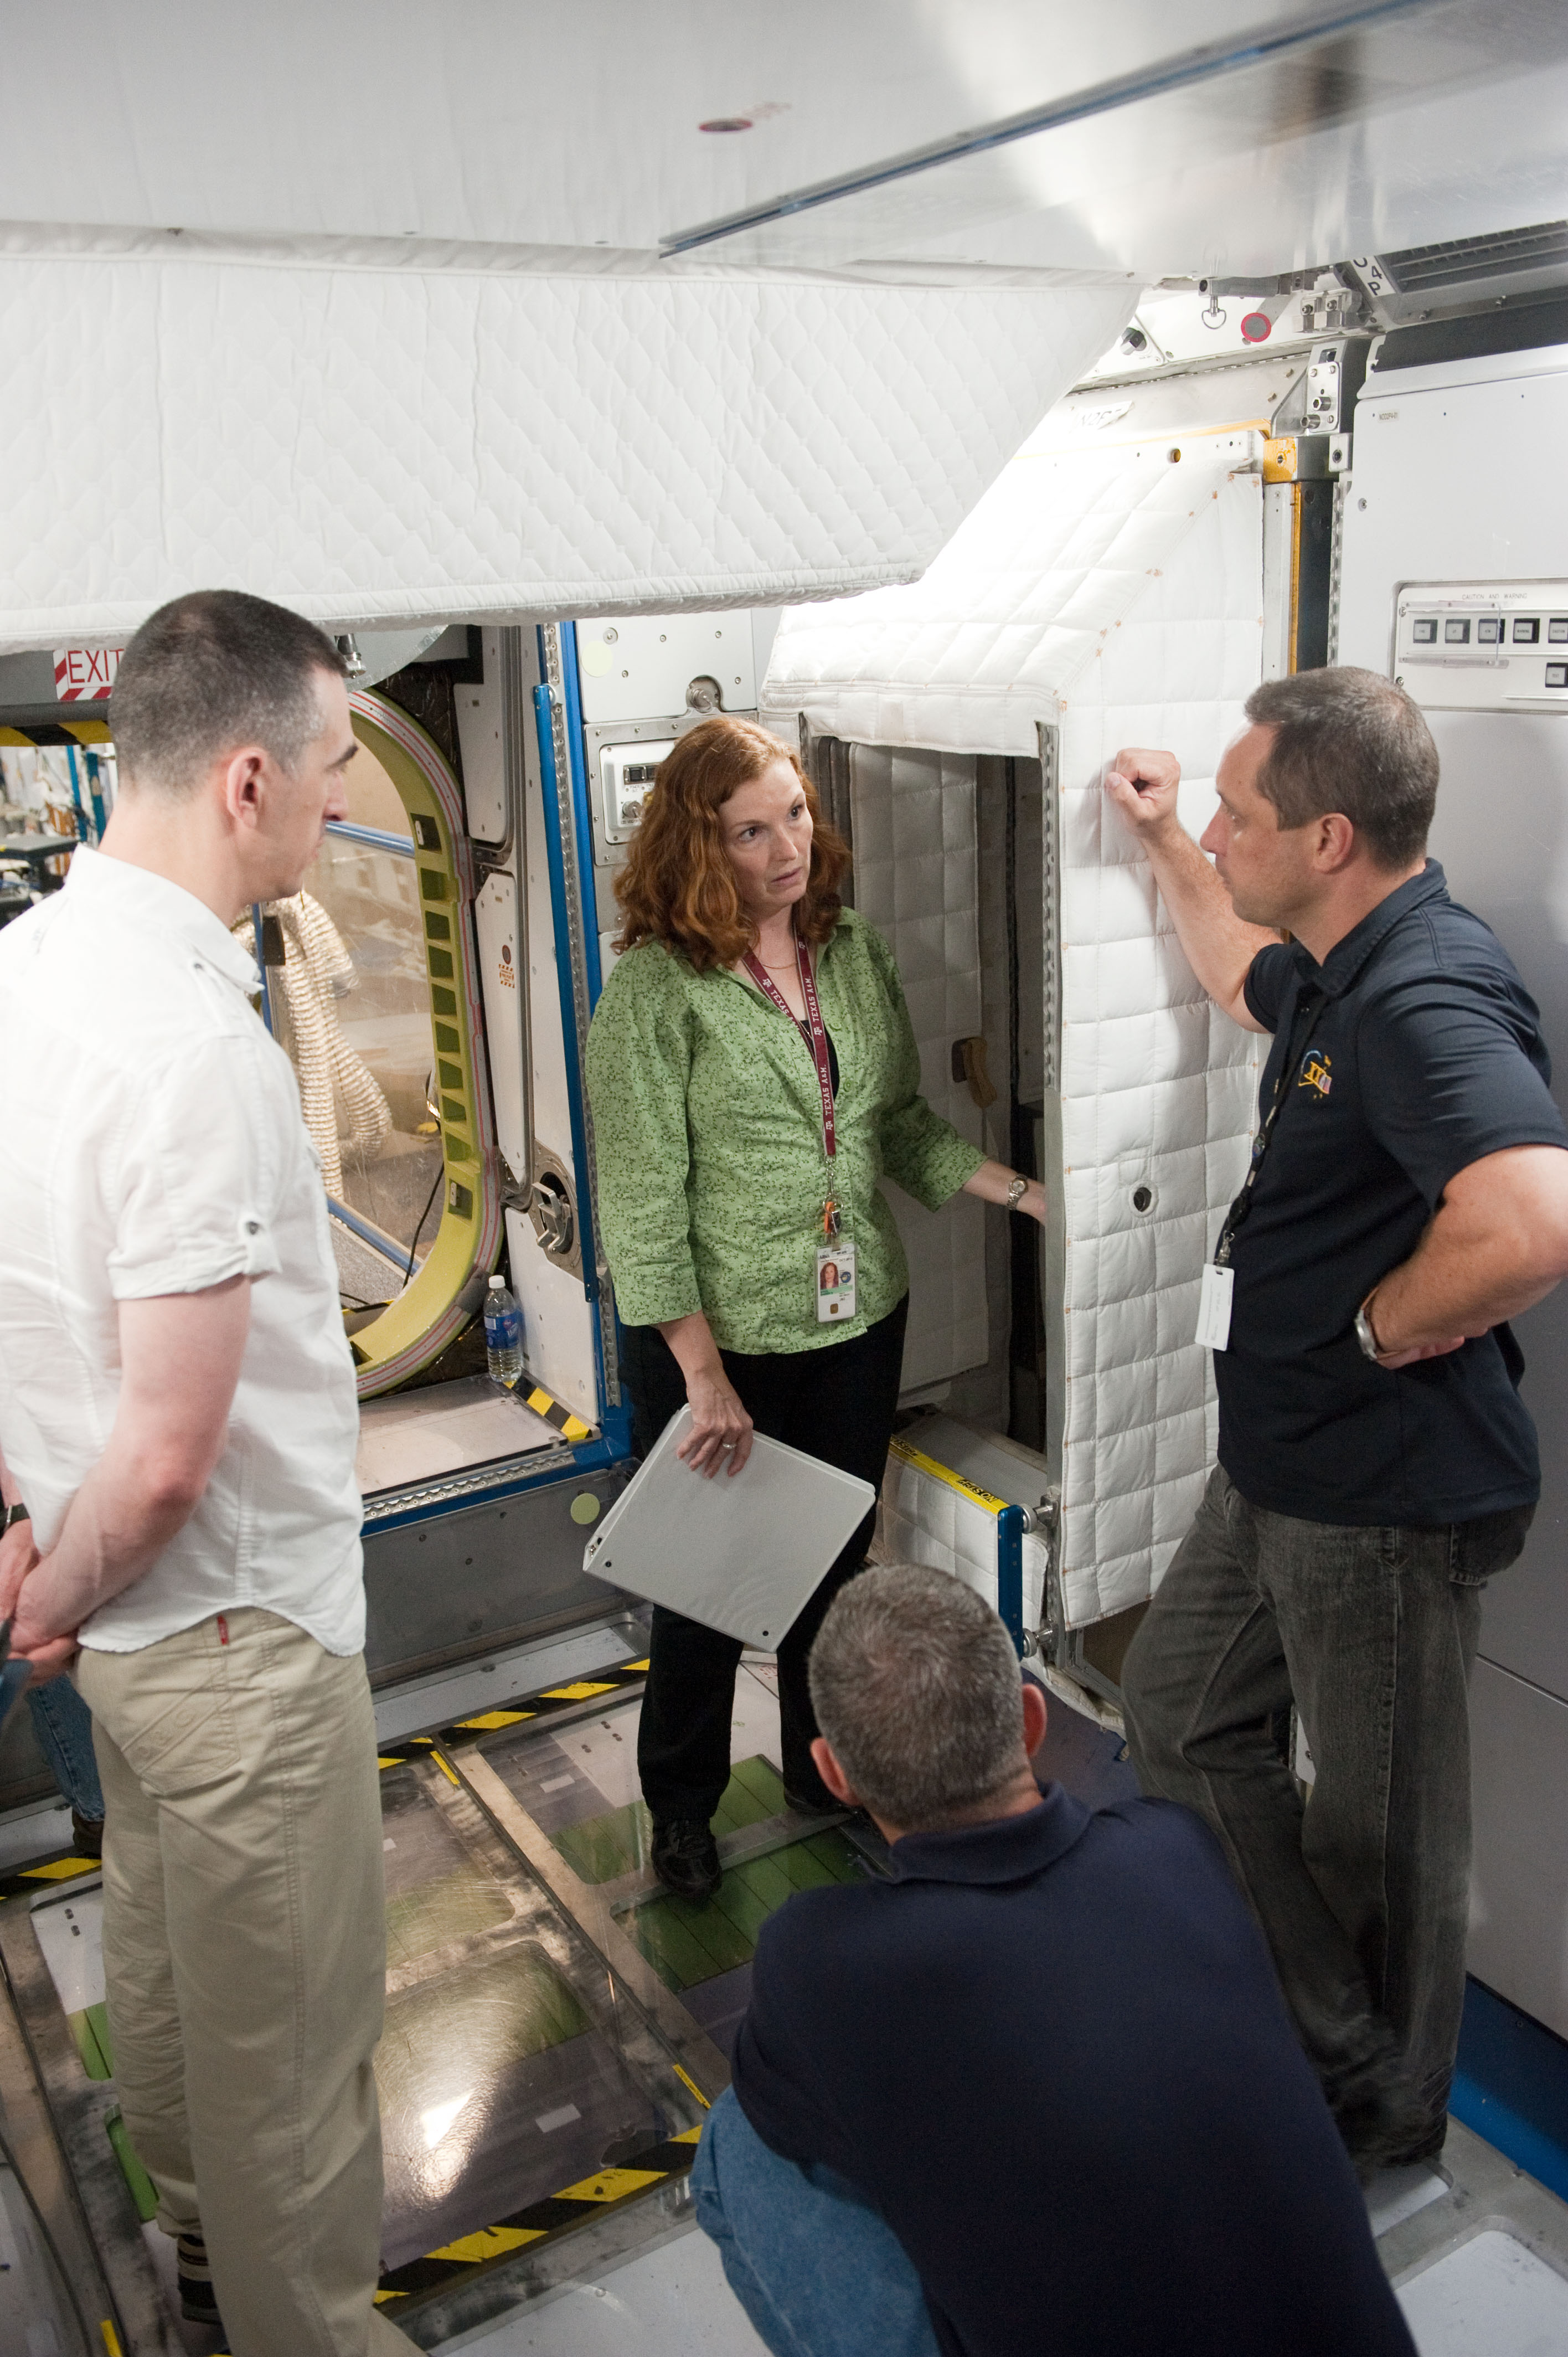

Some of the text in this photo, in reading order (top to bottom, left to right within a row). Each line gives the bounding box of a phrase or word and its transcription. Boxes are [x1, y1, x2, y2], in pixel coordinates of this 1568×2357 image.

[68, 649, 125, 683] EXIT
[770, 990, 790, 1015] TEXAS
[808, 996, 819, 1022] TEXAS
[822, 1087, 832, 1116] TEXAS
[981, 1493, 998, 1502] NO
